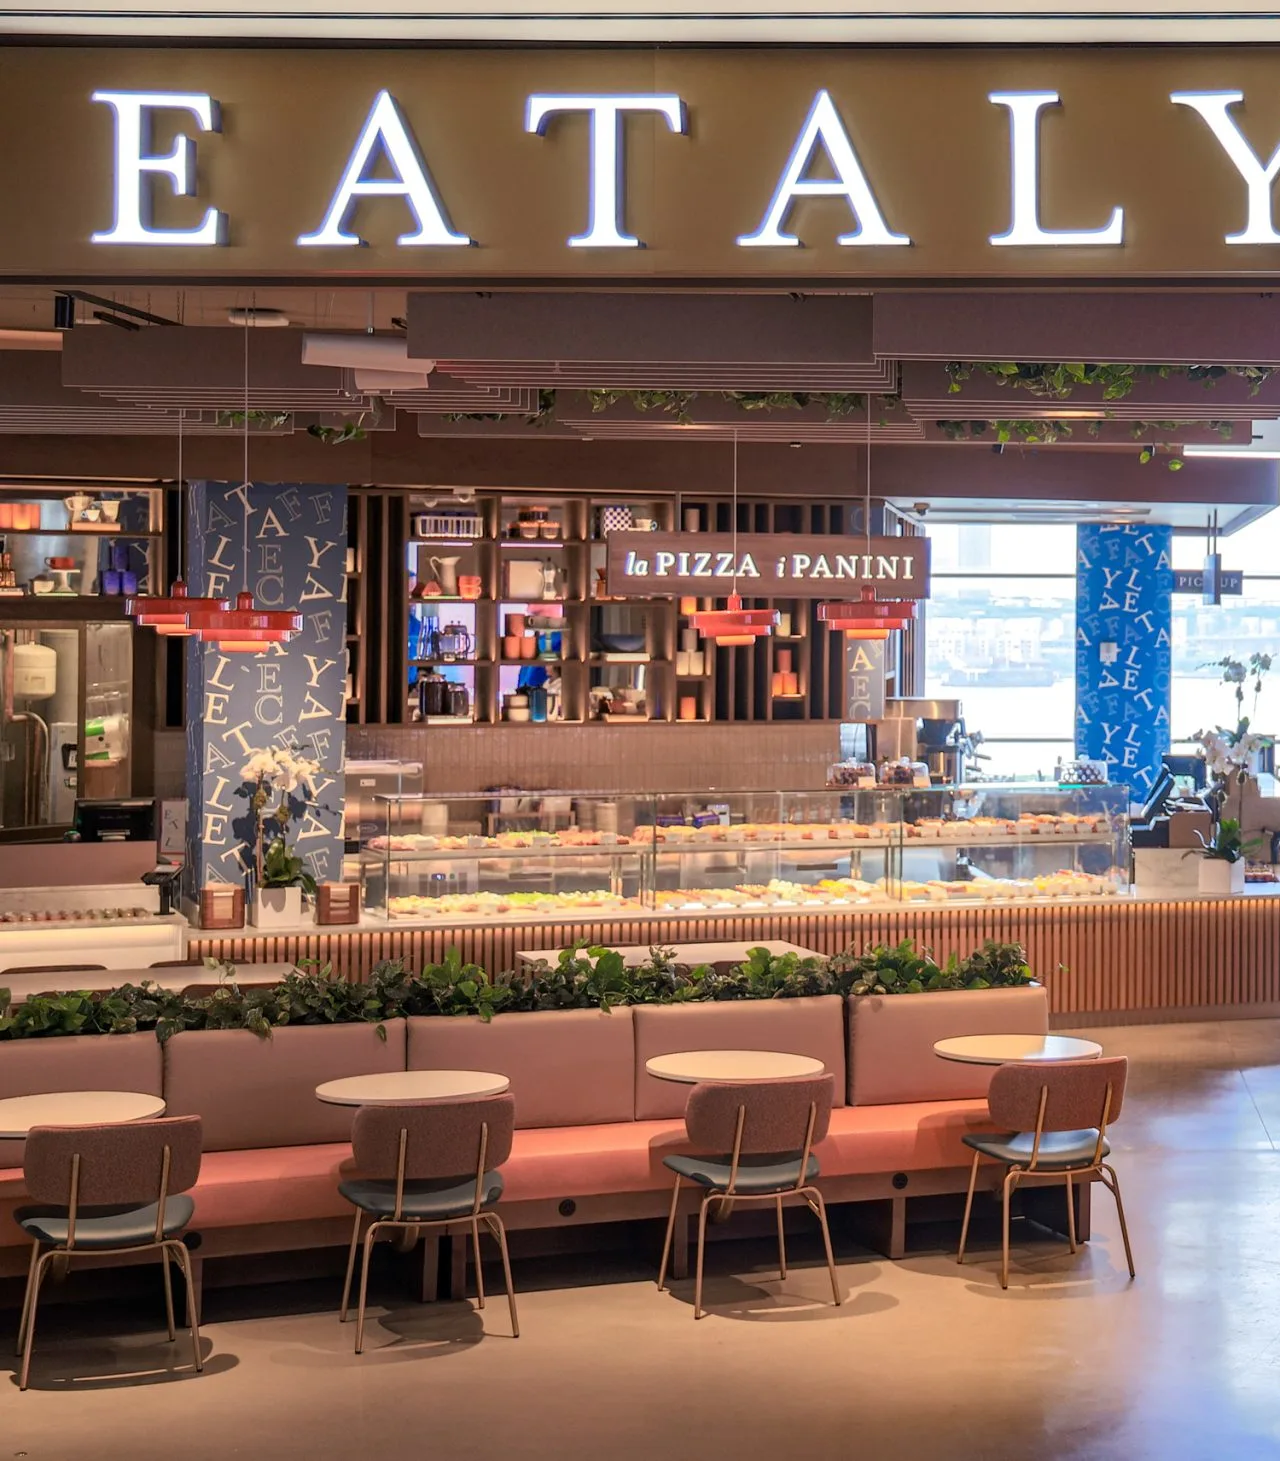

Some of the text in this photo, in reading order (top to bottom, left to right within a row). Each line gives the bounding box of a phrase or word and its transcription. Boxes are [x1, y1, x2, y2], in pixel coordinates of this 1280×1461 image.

[256, 507, 290, 538] A
[208, 535, 236, 571] L
[304, 535, 338, 569] Y
[624, 551, 915, 580] la PIZZA i PANINI
[1101, 567, 1123, 589] Y
[1125, 567, 1143, 592] L
[1122, 591, 1140, 613] E
[849, 646, 875, 672] A
[1125, 645, 1142, 669] L
[207, 655, 235, 691] L
[303, 654, 337, 688] Y
[1122, 669, 1139, 690] E
[203, 692, 230, 725] E
[1101, 722, 1121, 744] Y
[1124, 723, 1142, 747] L
[1122, 746, 1139, 768] E
[205, 775, 233, 811] L
[202, 813, 228, 845] E
